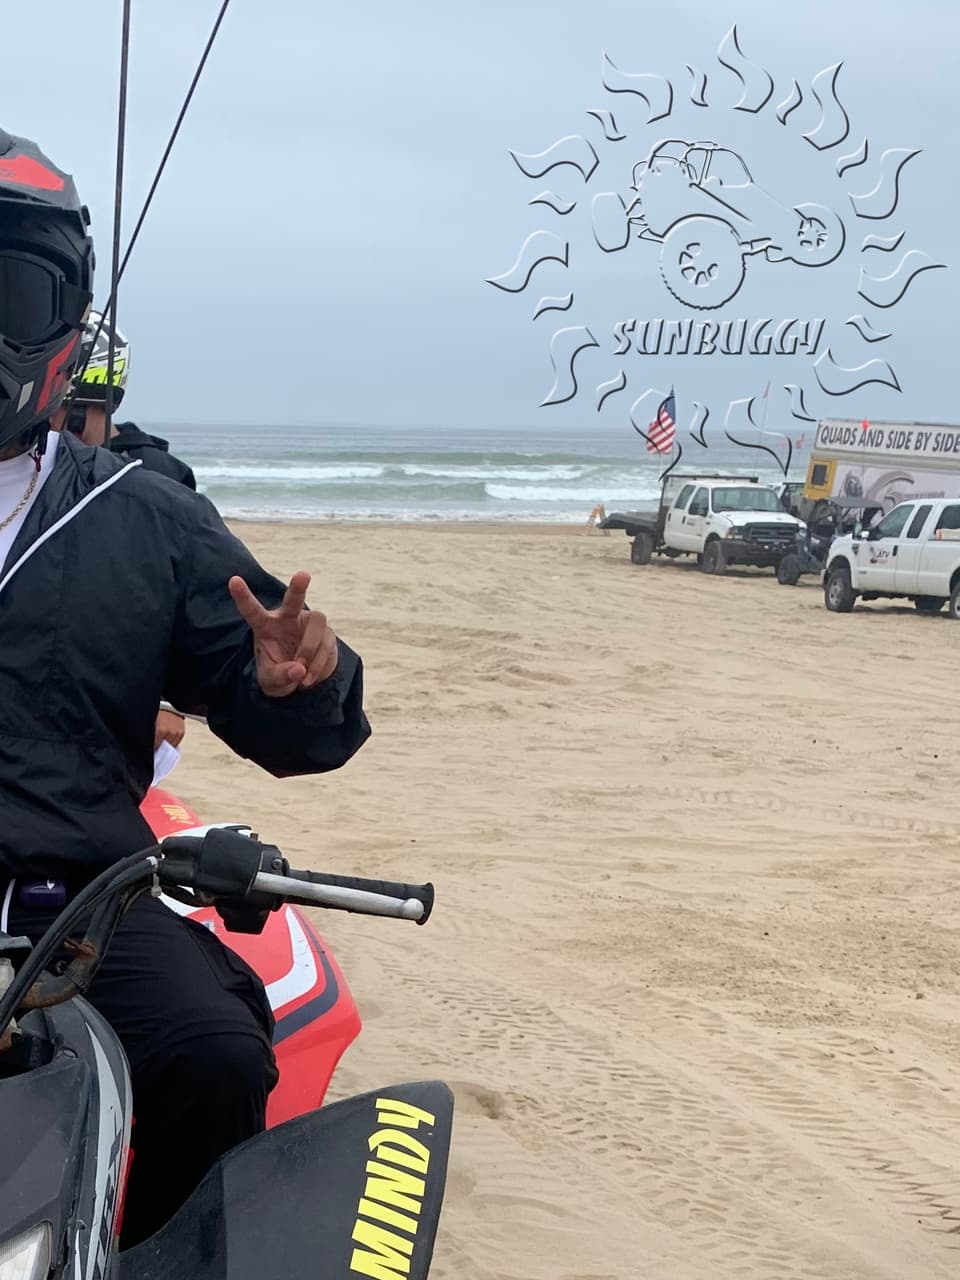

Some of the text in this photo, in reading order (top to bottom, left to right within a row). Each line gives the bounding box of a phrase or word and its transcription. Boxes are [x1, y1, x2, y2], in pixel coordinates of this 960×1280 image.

[820, 425, 960, 453] QUADS AND SIDE BY SIDE
